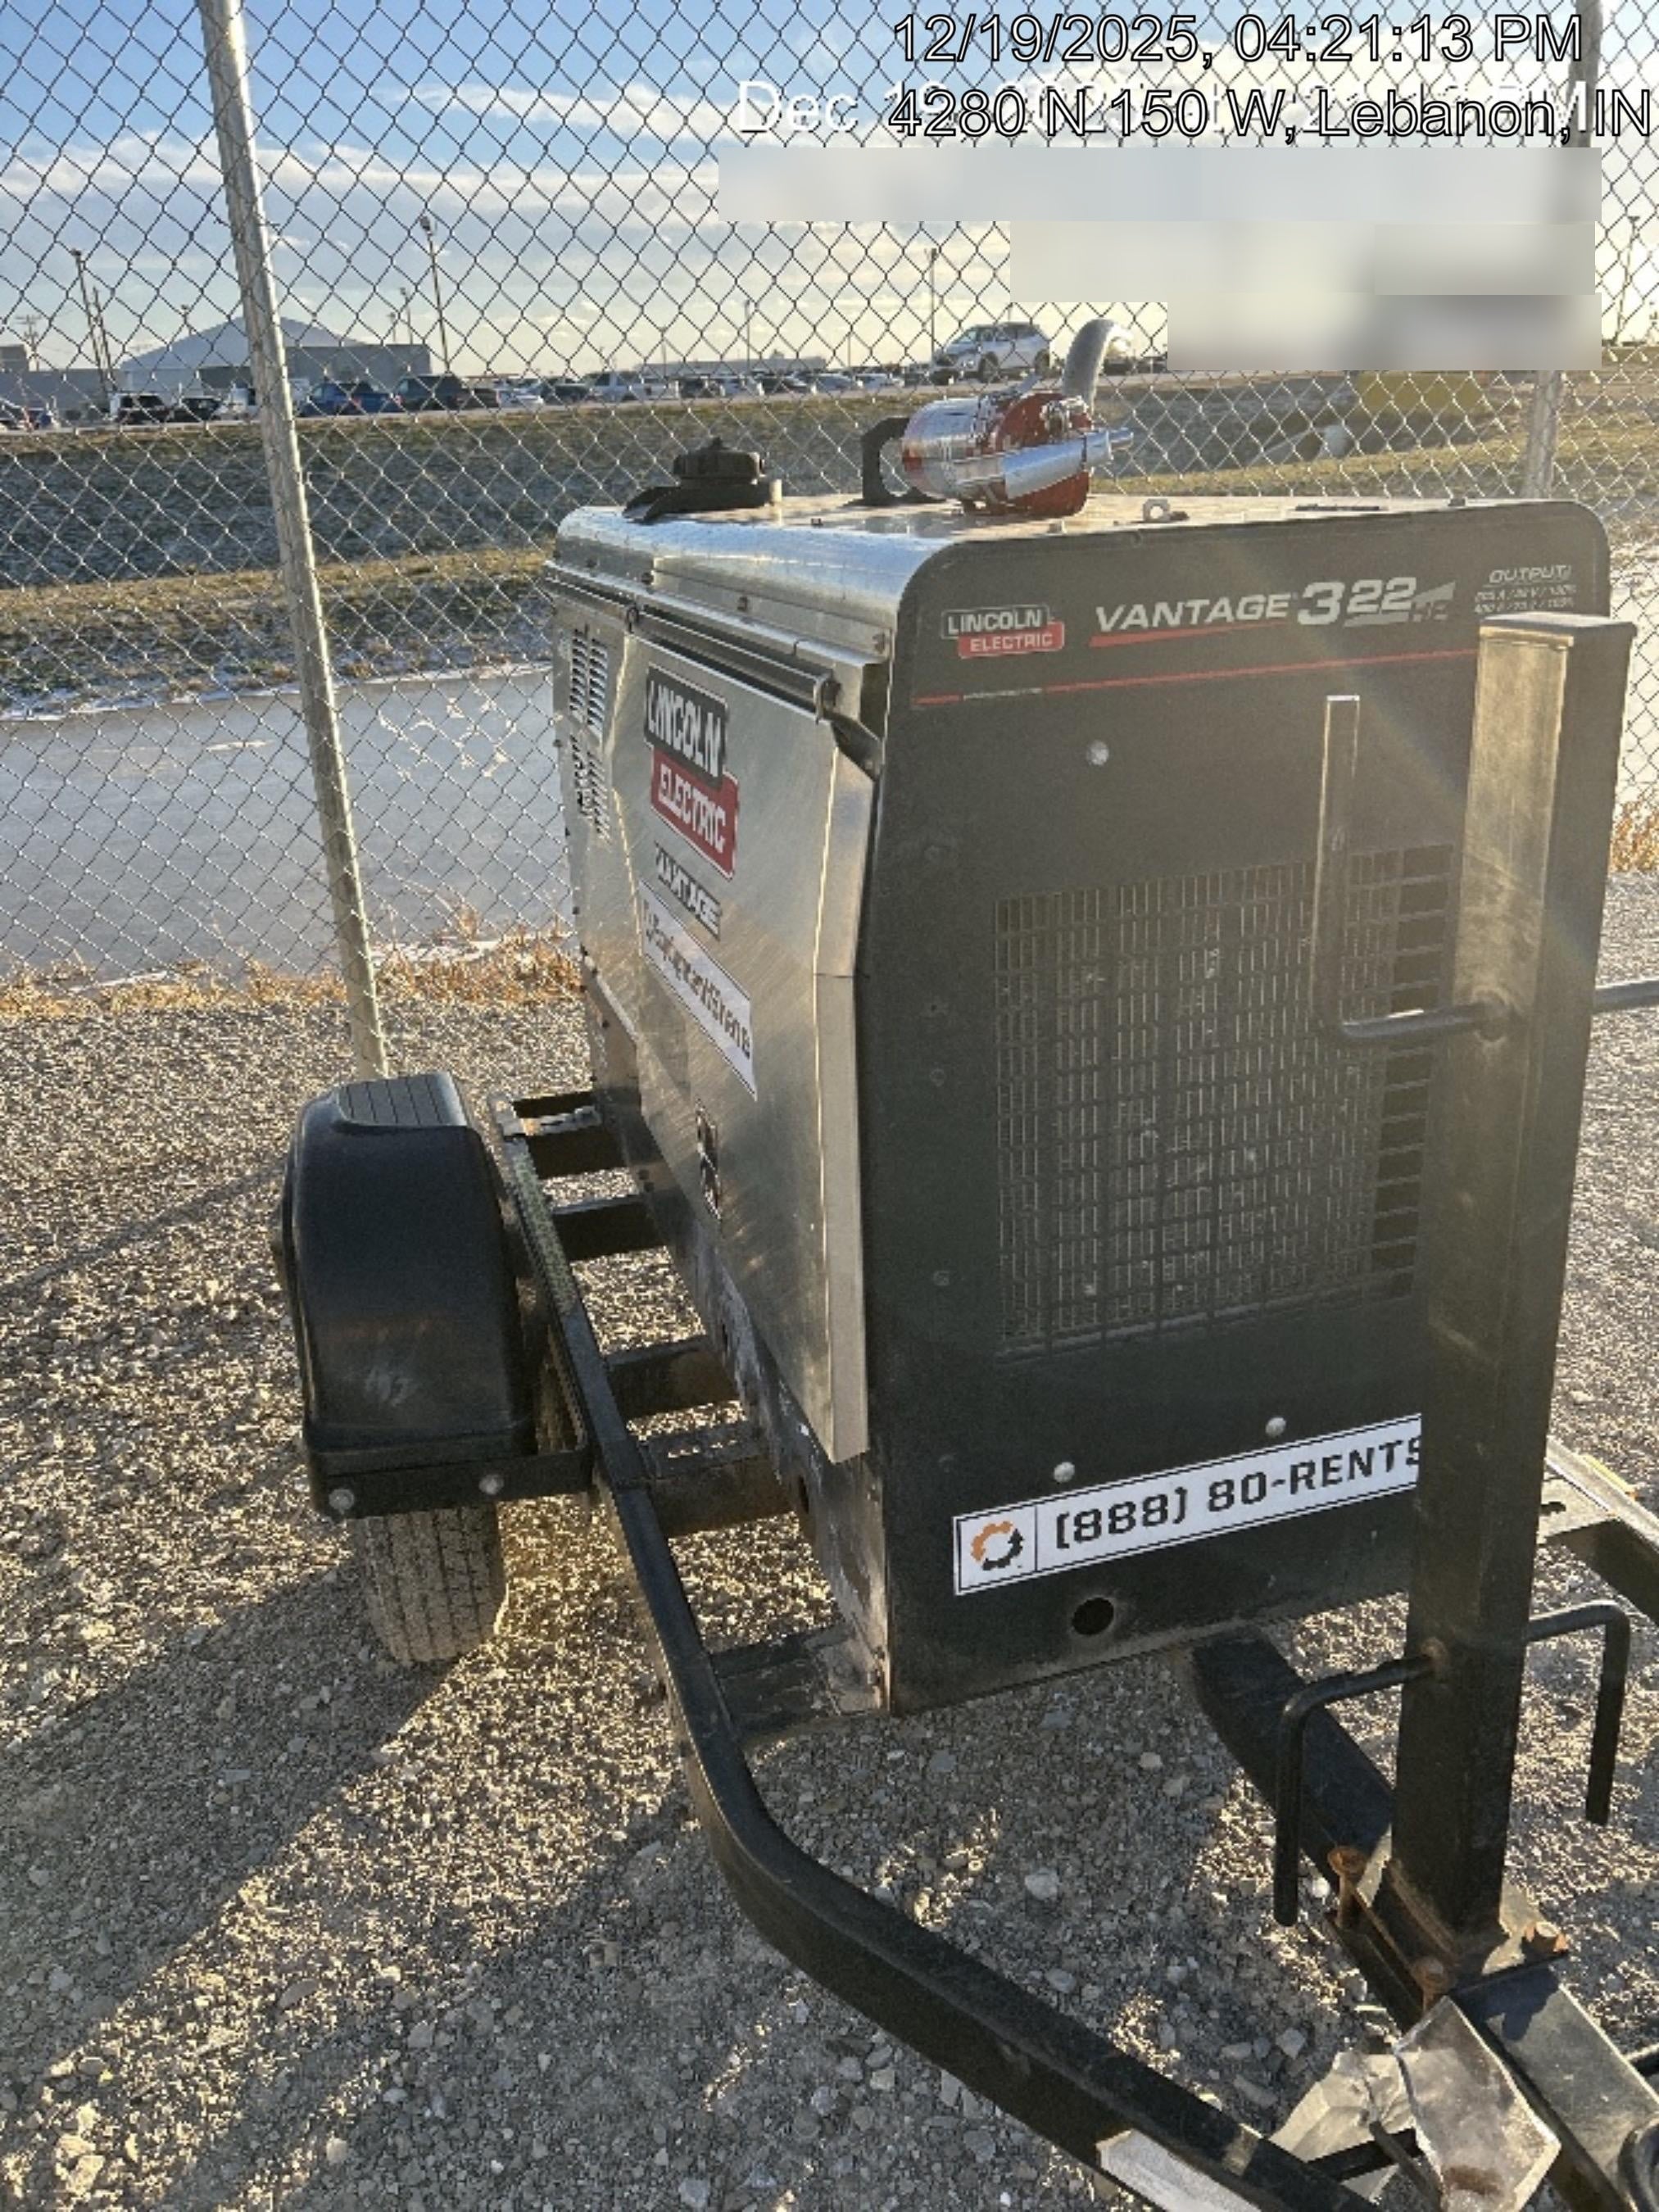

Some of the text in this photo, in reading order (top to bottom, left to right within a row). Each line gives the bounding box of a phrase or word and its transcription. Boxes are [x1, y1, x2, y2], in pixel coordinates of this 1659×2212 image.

[947, 609, 1042, 635] LINCOLN
[1095, 592, 1291, 632] VANTAGE
[1297, 576, 1417, 625] 322
[969, 632, 1054, 653] ELECTRIC
[647, 679, 722, 778] LINCOLN
[658, 762, 727, 854] ELECTRIC
[1056, 1435, 1422, 1550] (888) 80-RENTS
